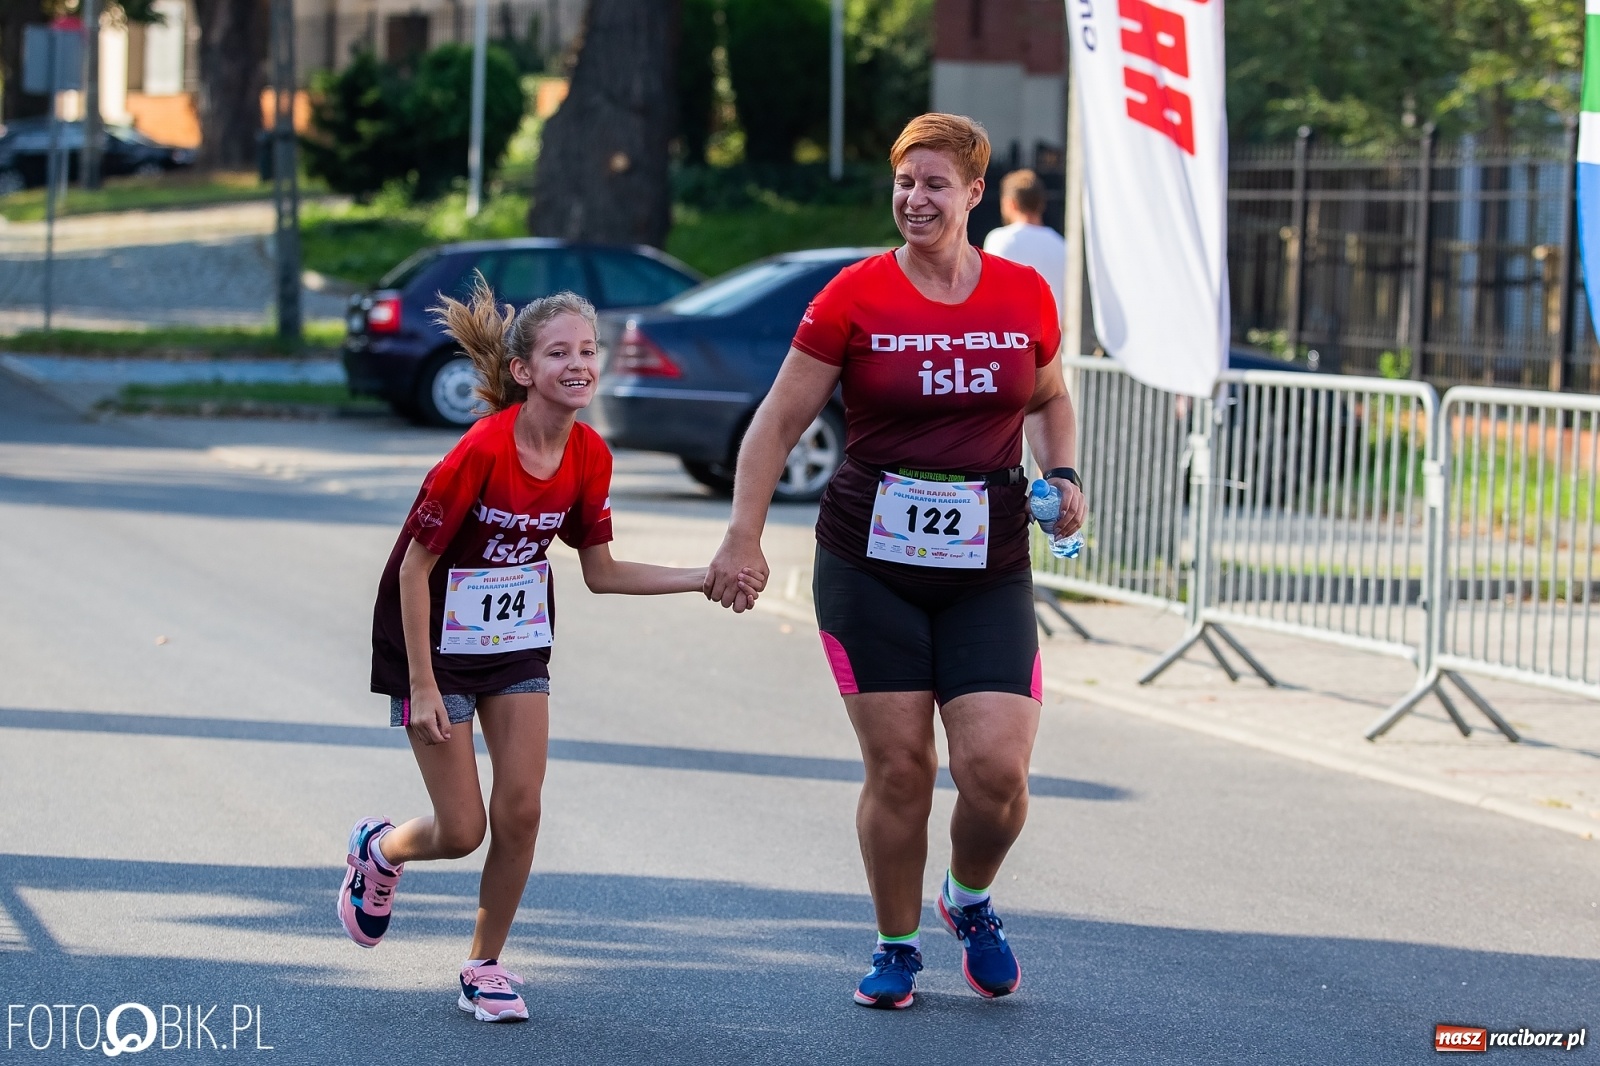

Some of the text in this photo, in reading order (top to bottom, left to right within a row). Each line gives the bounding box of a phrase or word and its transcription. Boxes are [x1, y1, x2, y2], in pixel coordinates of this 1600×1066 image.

[871, 331, 1030, 352] DAR-BUD
[908, 487, 925, 495] MINI
[906, 504, 962, 536] 122
[500, 573, 524, 582] RAFAKO
[481, 589, 526, 622] 124
